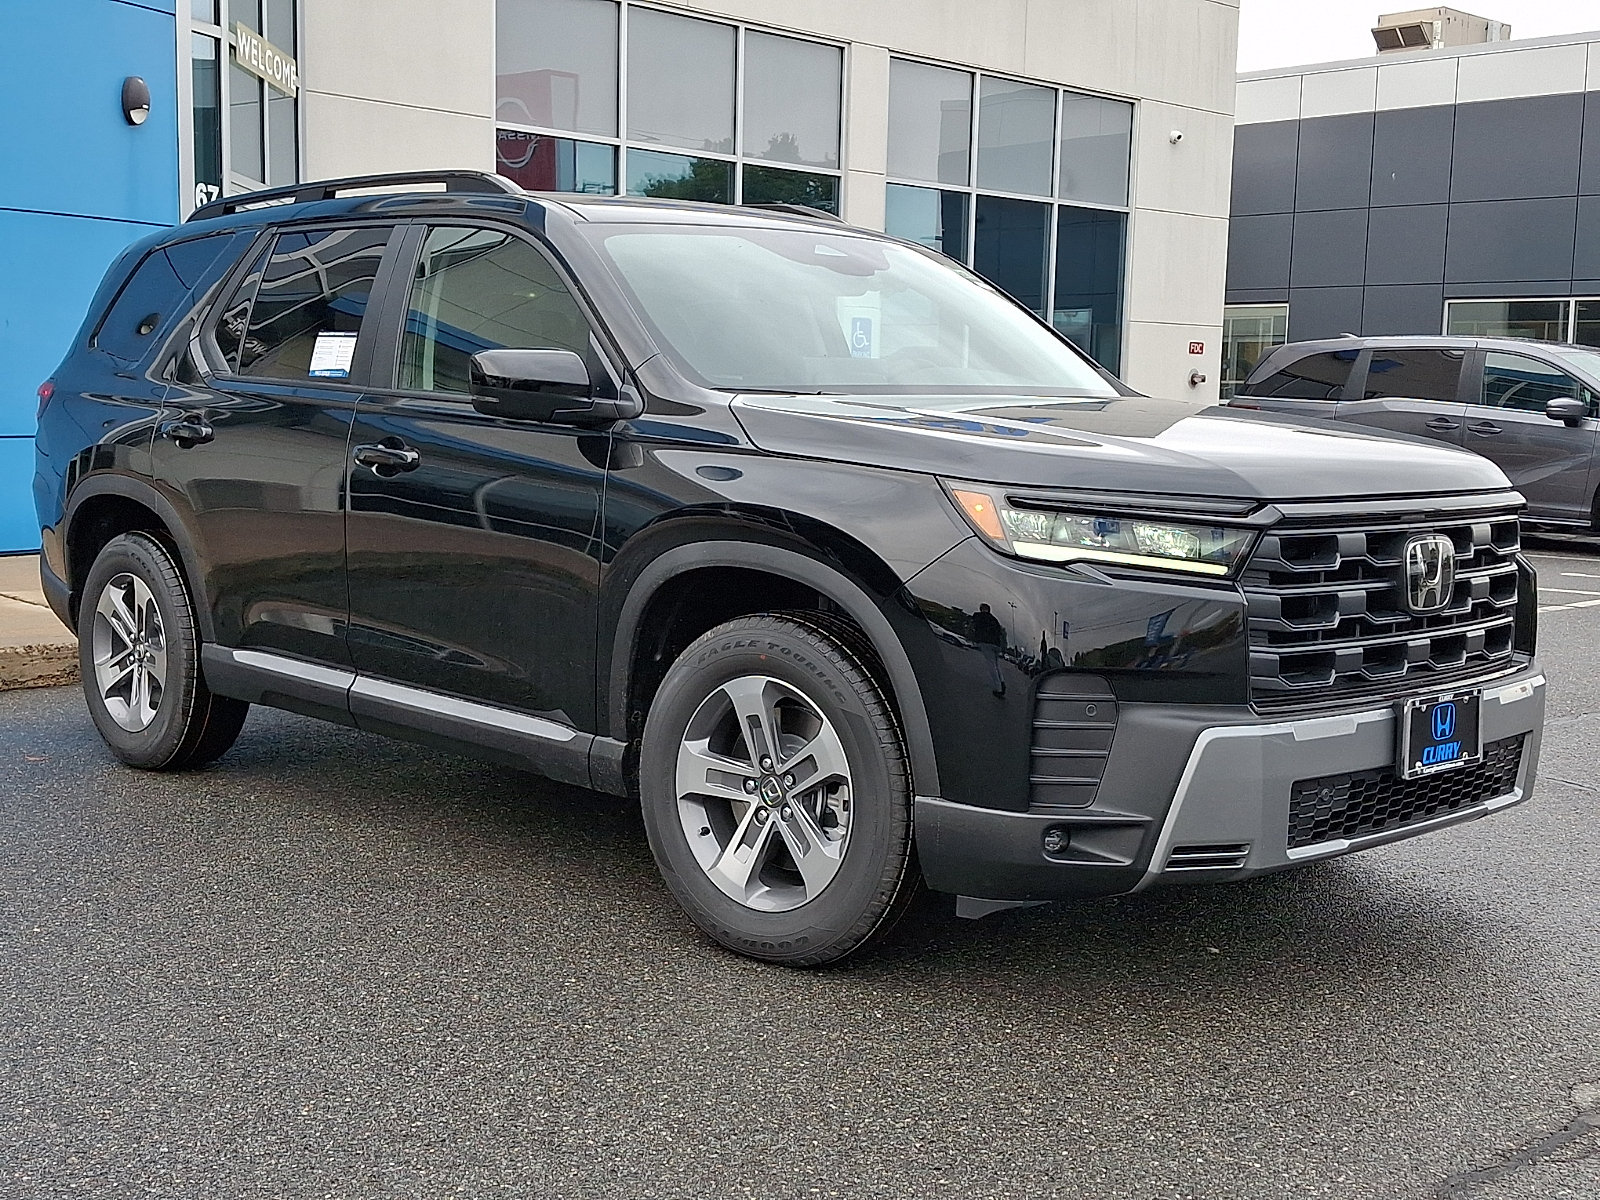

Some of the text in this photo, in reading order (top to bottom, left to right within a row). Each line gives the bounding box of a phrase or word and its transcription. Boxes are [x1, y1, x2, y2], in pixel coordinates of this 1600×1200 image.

[236, 28, 297, 91] WELCOME
[195, 182, 220, 209] 67
[1190, 343, 1203, 354] FDC
[697, 639, 847, 703] EAGLE TOURING
[1422, 741, 1461, 765] CURRY
